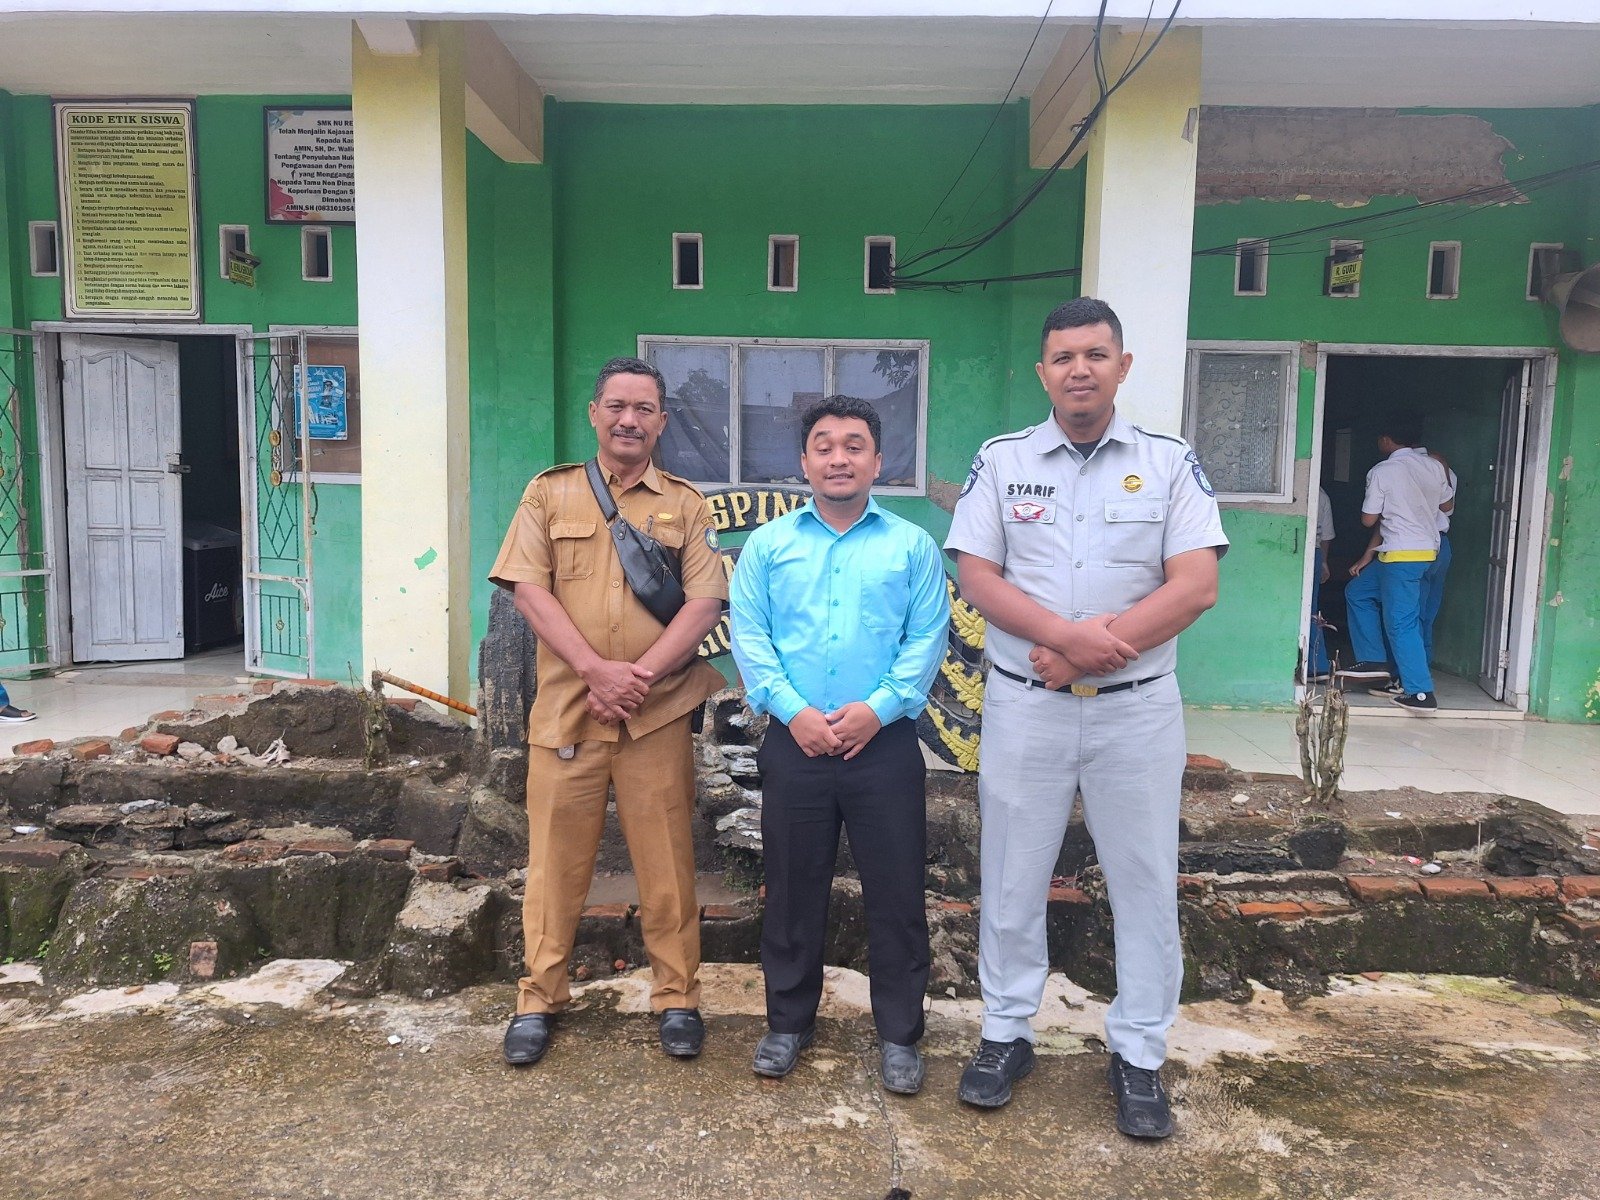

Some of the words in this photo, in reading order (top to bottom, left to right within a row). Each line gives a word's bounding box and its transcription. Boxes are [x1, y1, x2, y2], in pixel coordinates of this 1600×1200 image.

[141, 116, 180, 124] SISWA
[1342, 264, 1356, 274] GURU
[1007, 484, 1056, 498] SYARIF
[707, 492, 811, 530] SPIN
[204, 582, 228, 602] Aice
